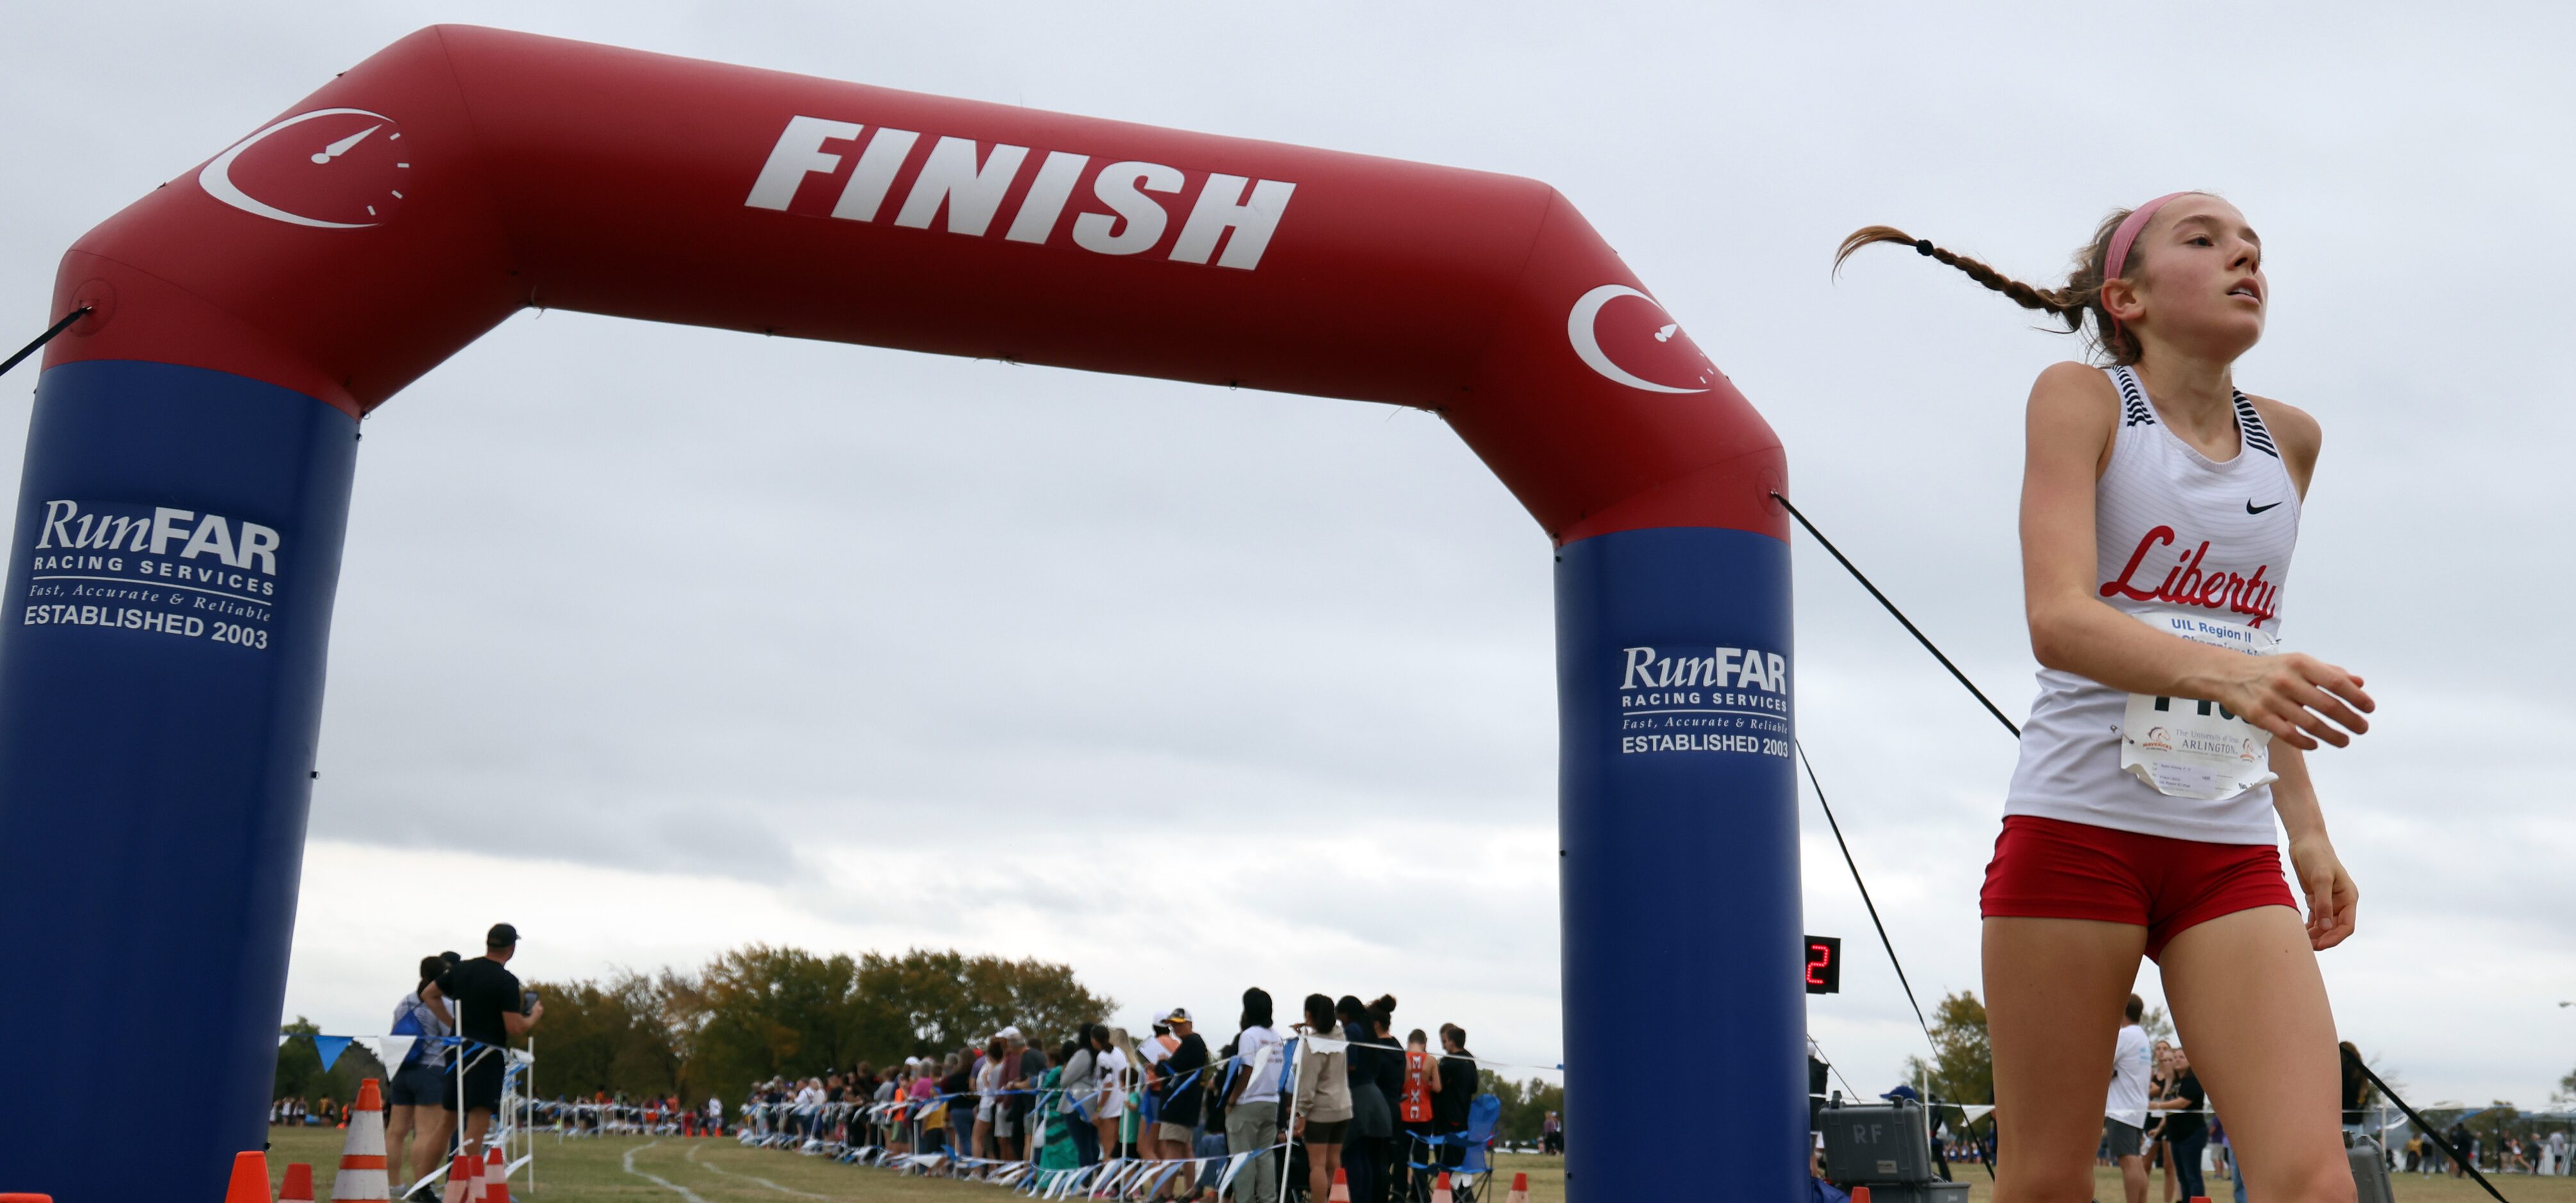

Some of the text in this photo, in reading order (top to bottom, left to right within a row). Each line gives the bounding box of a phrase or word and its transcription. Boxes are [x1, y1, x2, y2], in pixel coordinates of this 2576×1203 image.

[744, 115, 1297, 270] FINISH
[35, 500, 280, 575] RunFAR
[34, 555, 274, 596] RACING SERVICES
[2099, 525, 2276, 630] Liberty
[29, 585, 271, 622] Fast, Accurate & Reliable
[24, 605, 268, 650] ESTABLISHED 2003
[2172, 618, 2195, 631] UIL
[2199, 622, 2242, 640] Region
[1620, 647, 1786, 694] RunFAR
[1622, 692, 1787, 712] RACING SERVICES
[1623, 717, 1787, 734] Fast, Accurate & Reliable
[2191, 731, 2220, 742] University
[1623, 734, 1788, 758] ESTABLISHED 2003
[2182, 739, 2235, 754] ARLINGTON
[1806, 944, 1830, 985] 2
[1853, 1124, 1882, 1144] RF
